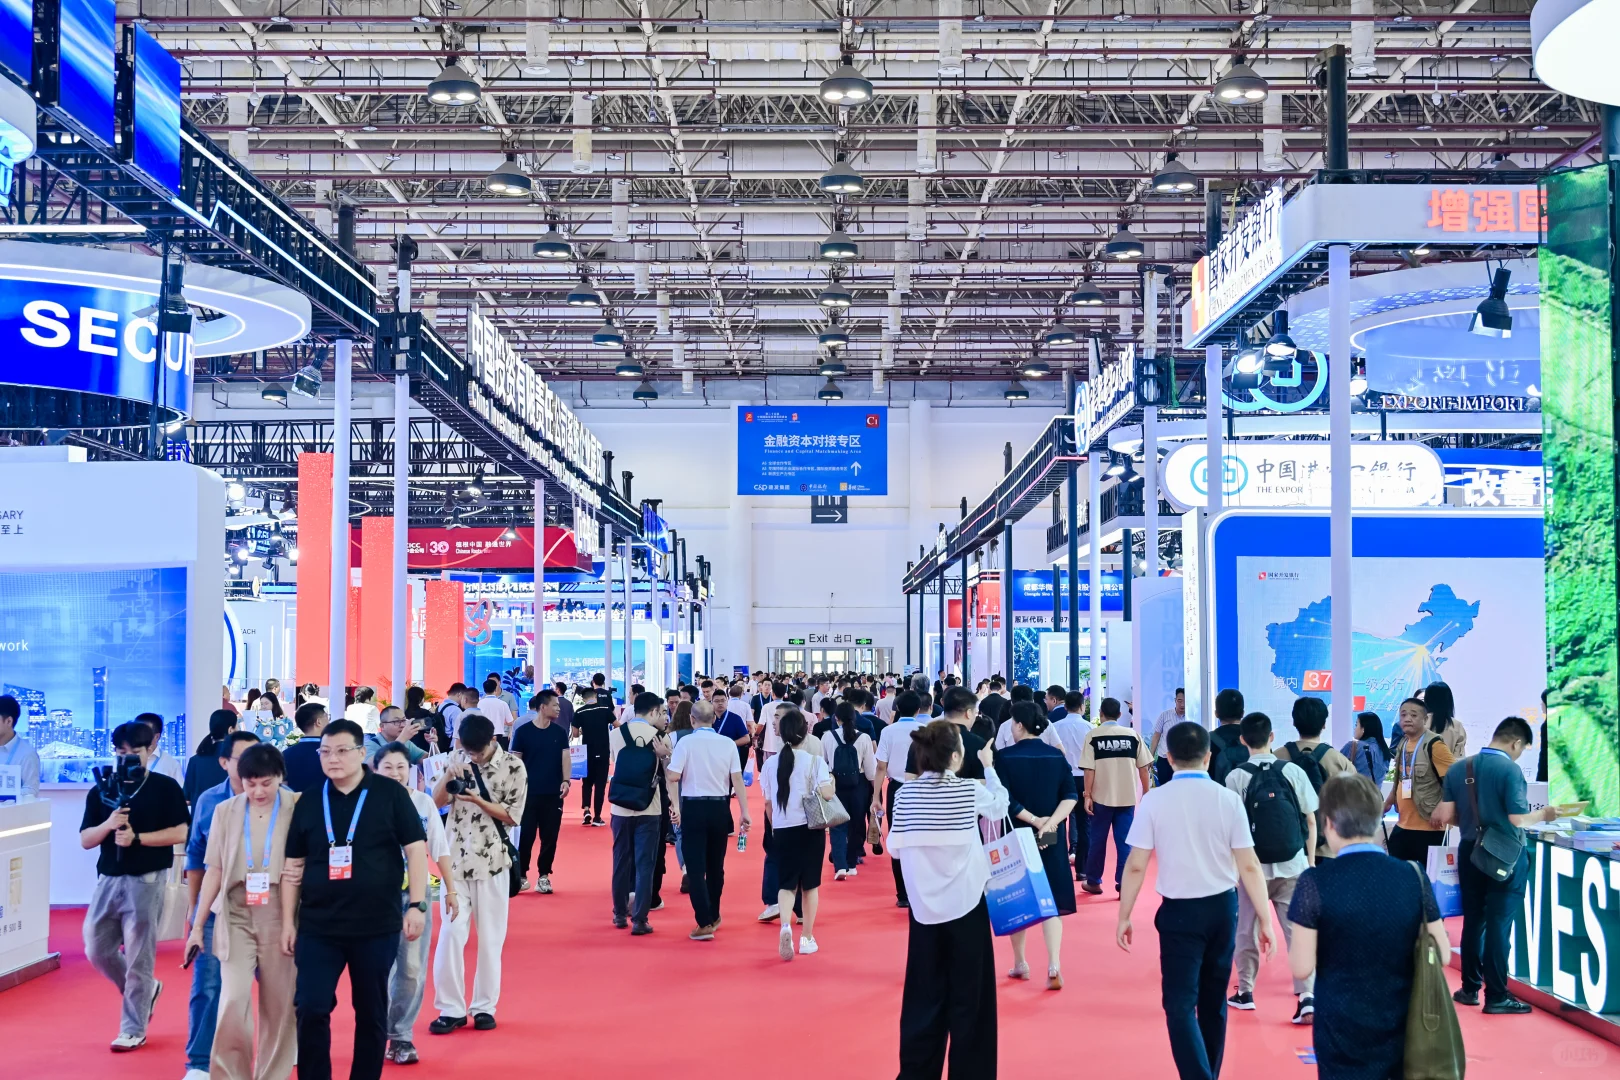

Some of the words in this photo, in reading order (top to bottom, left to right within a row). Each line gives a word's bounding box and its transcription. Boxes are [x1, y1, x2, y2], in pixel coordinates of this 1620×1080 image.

[764, 435, 861, 447] 金融资本对接专区
[1256, 486, 1273, 494] THE
[1, 524, 24, 535] 至上
[809, 633, 828, 643] Exit
[833, 634, 852, 643] 出口
[1273, 677, 1298, 689] 境内
[1308, 672, 1332, 688] 37
